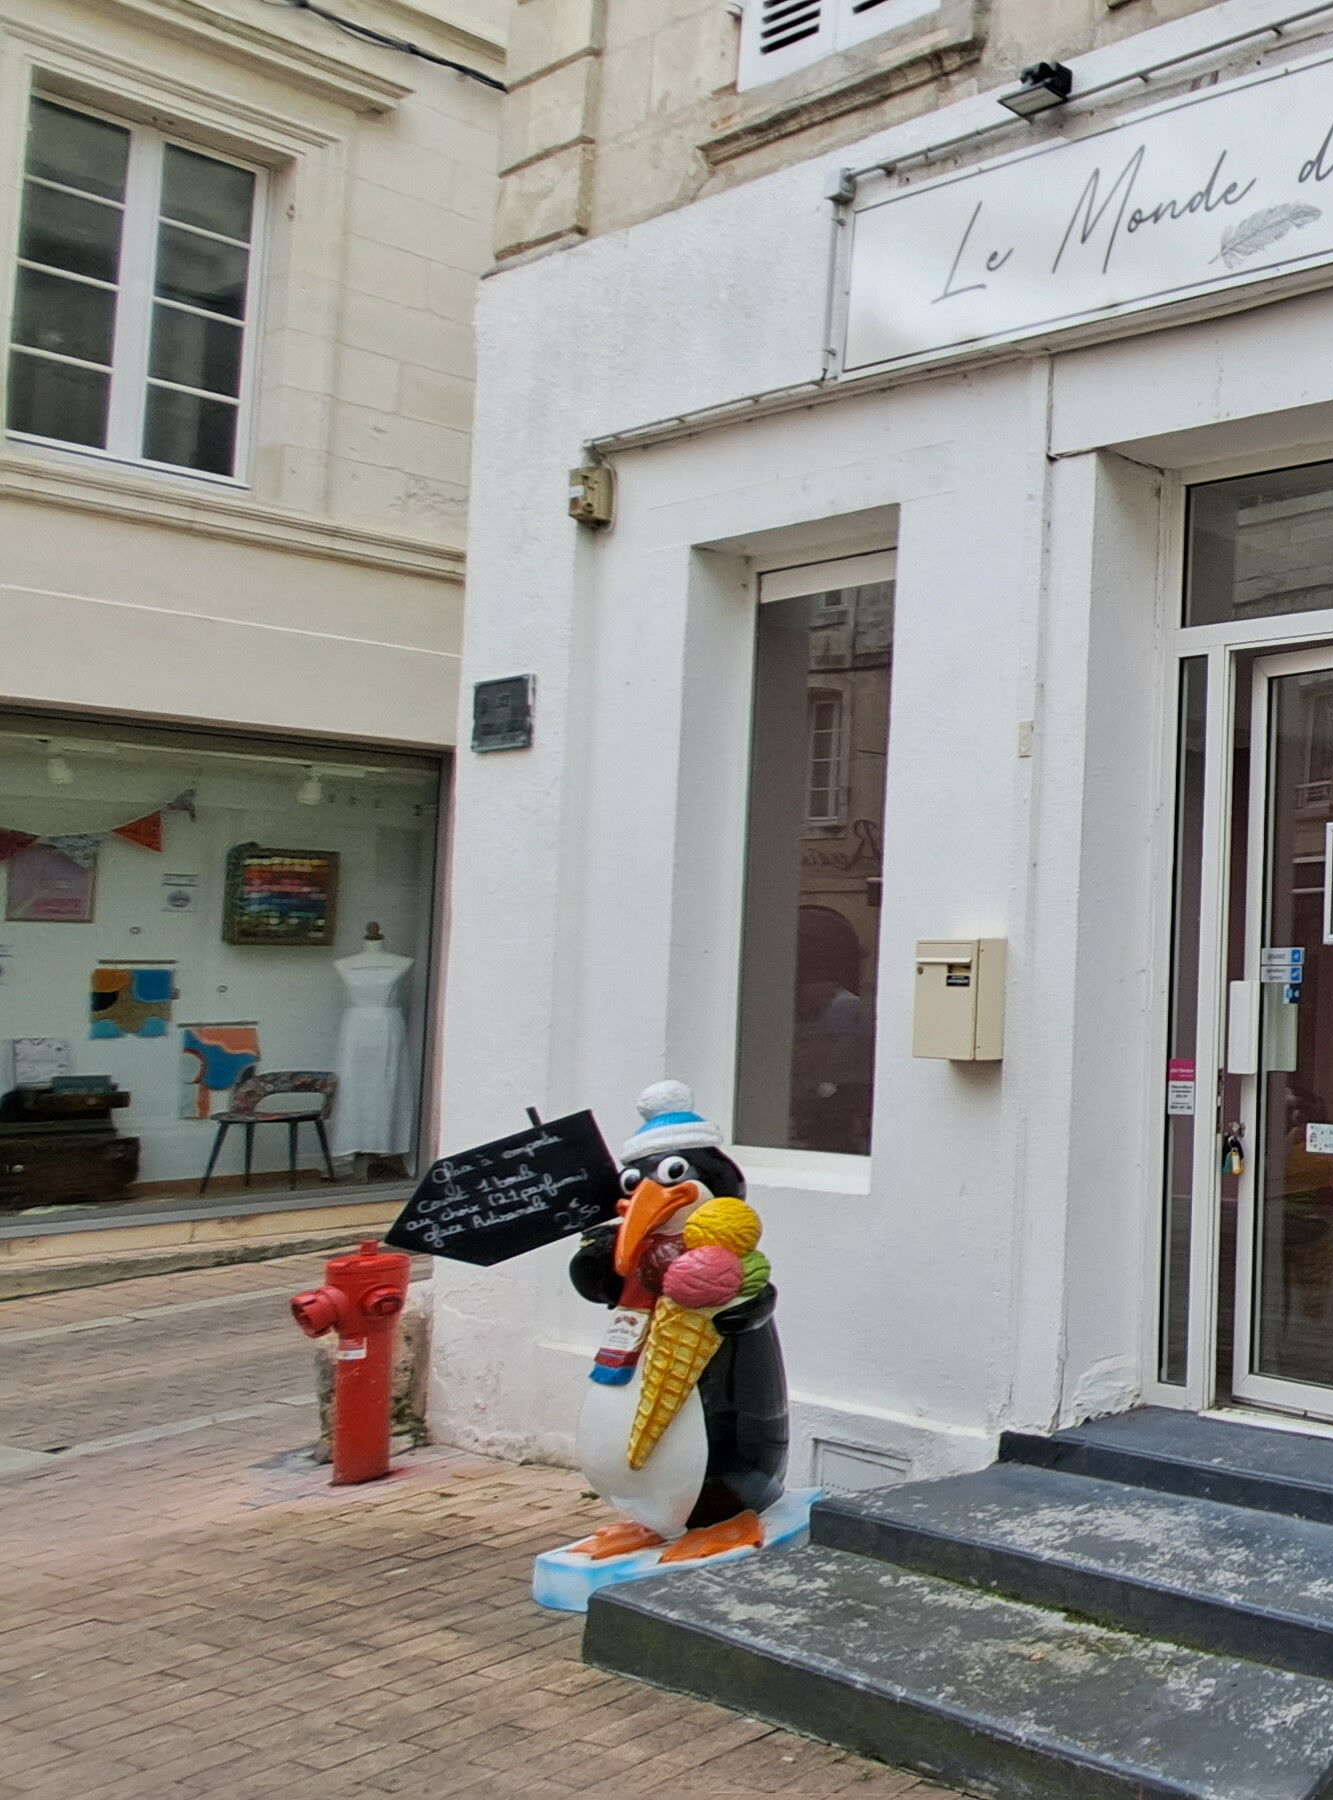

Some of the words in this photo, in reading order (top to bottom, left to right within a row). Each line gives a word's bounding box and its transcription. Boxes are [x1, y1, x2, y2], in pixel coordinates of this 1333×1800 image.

[930, 200, 1012, 305] Le
[1051, 143, 1256, 275] Monde
[476, 1178, 493, 1193] 1
[405, 1217, 434, 1232] au
[441, 1204, 483, 1222] choix
